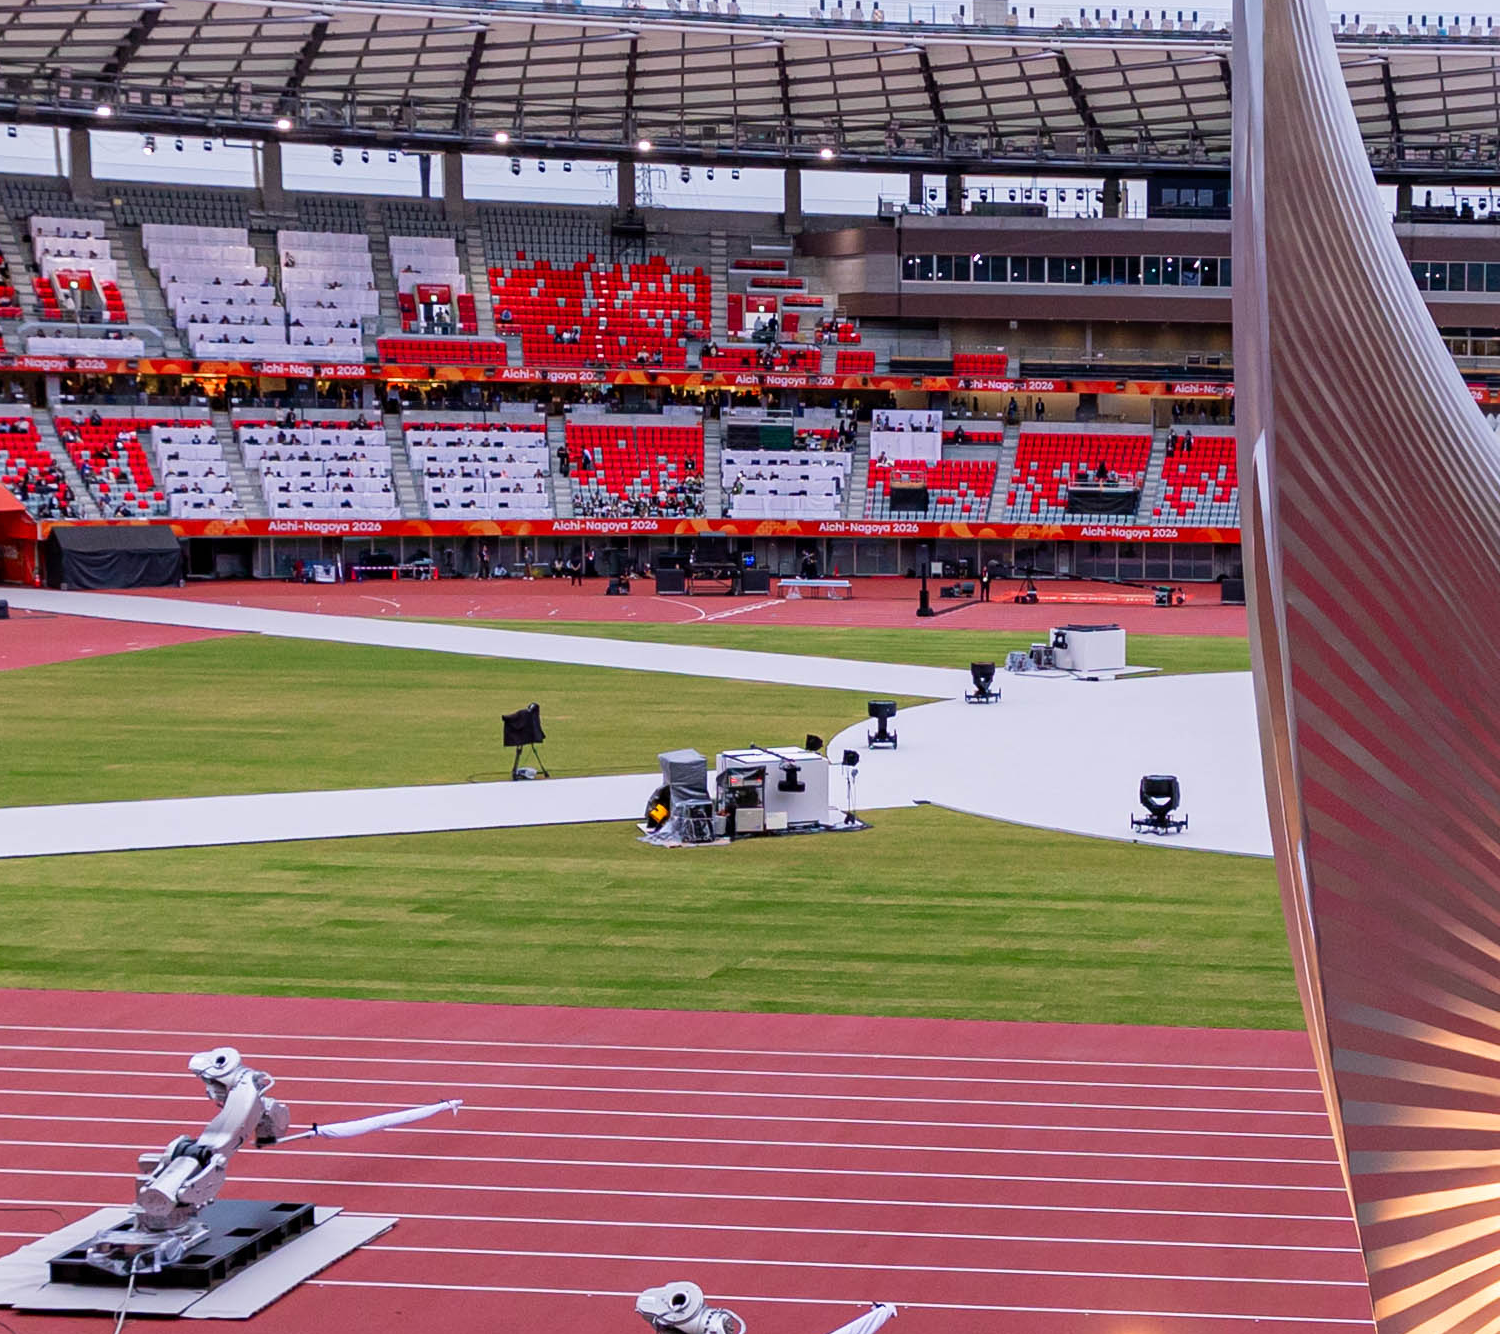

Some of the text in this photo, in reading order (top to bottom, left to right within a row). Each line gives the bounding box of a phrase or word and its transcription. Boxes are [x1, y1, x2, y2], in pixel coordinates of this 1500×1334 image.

[337, 366, 366, 375] 2026
[1029, 381, 1054, 390] 2026
[268, 521, 381, 533] Aichi-Nagoya 2026
[552, 521, 658, 533] Aichi-Nagoya 2026
[819, 522, 919, 534] Aichi-Nagoya 2026
[1081, 527, 1178, 538] Aichi-Nagoya 2026
